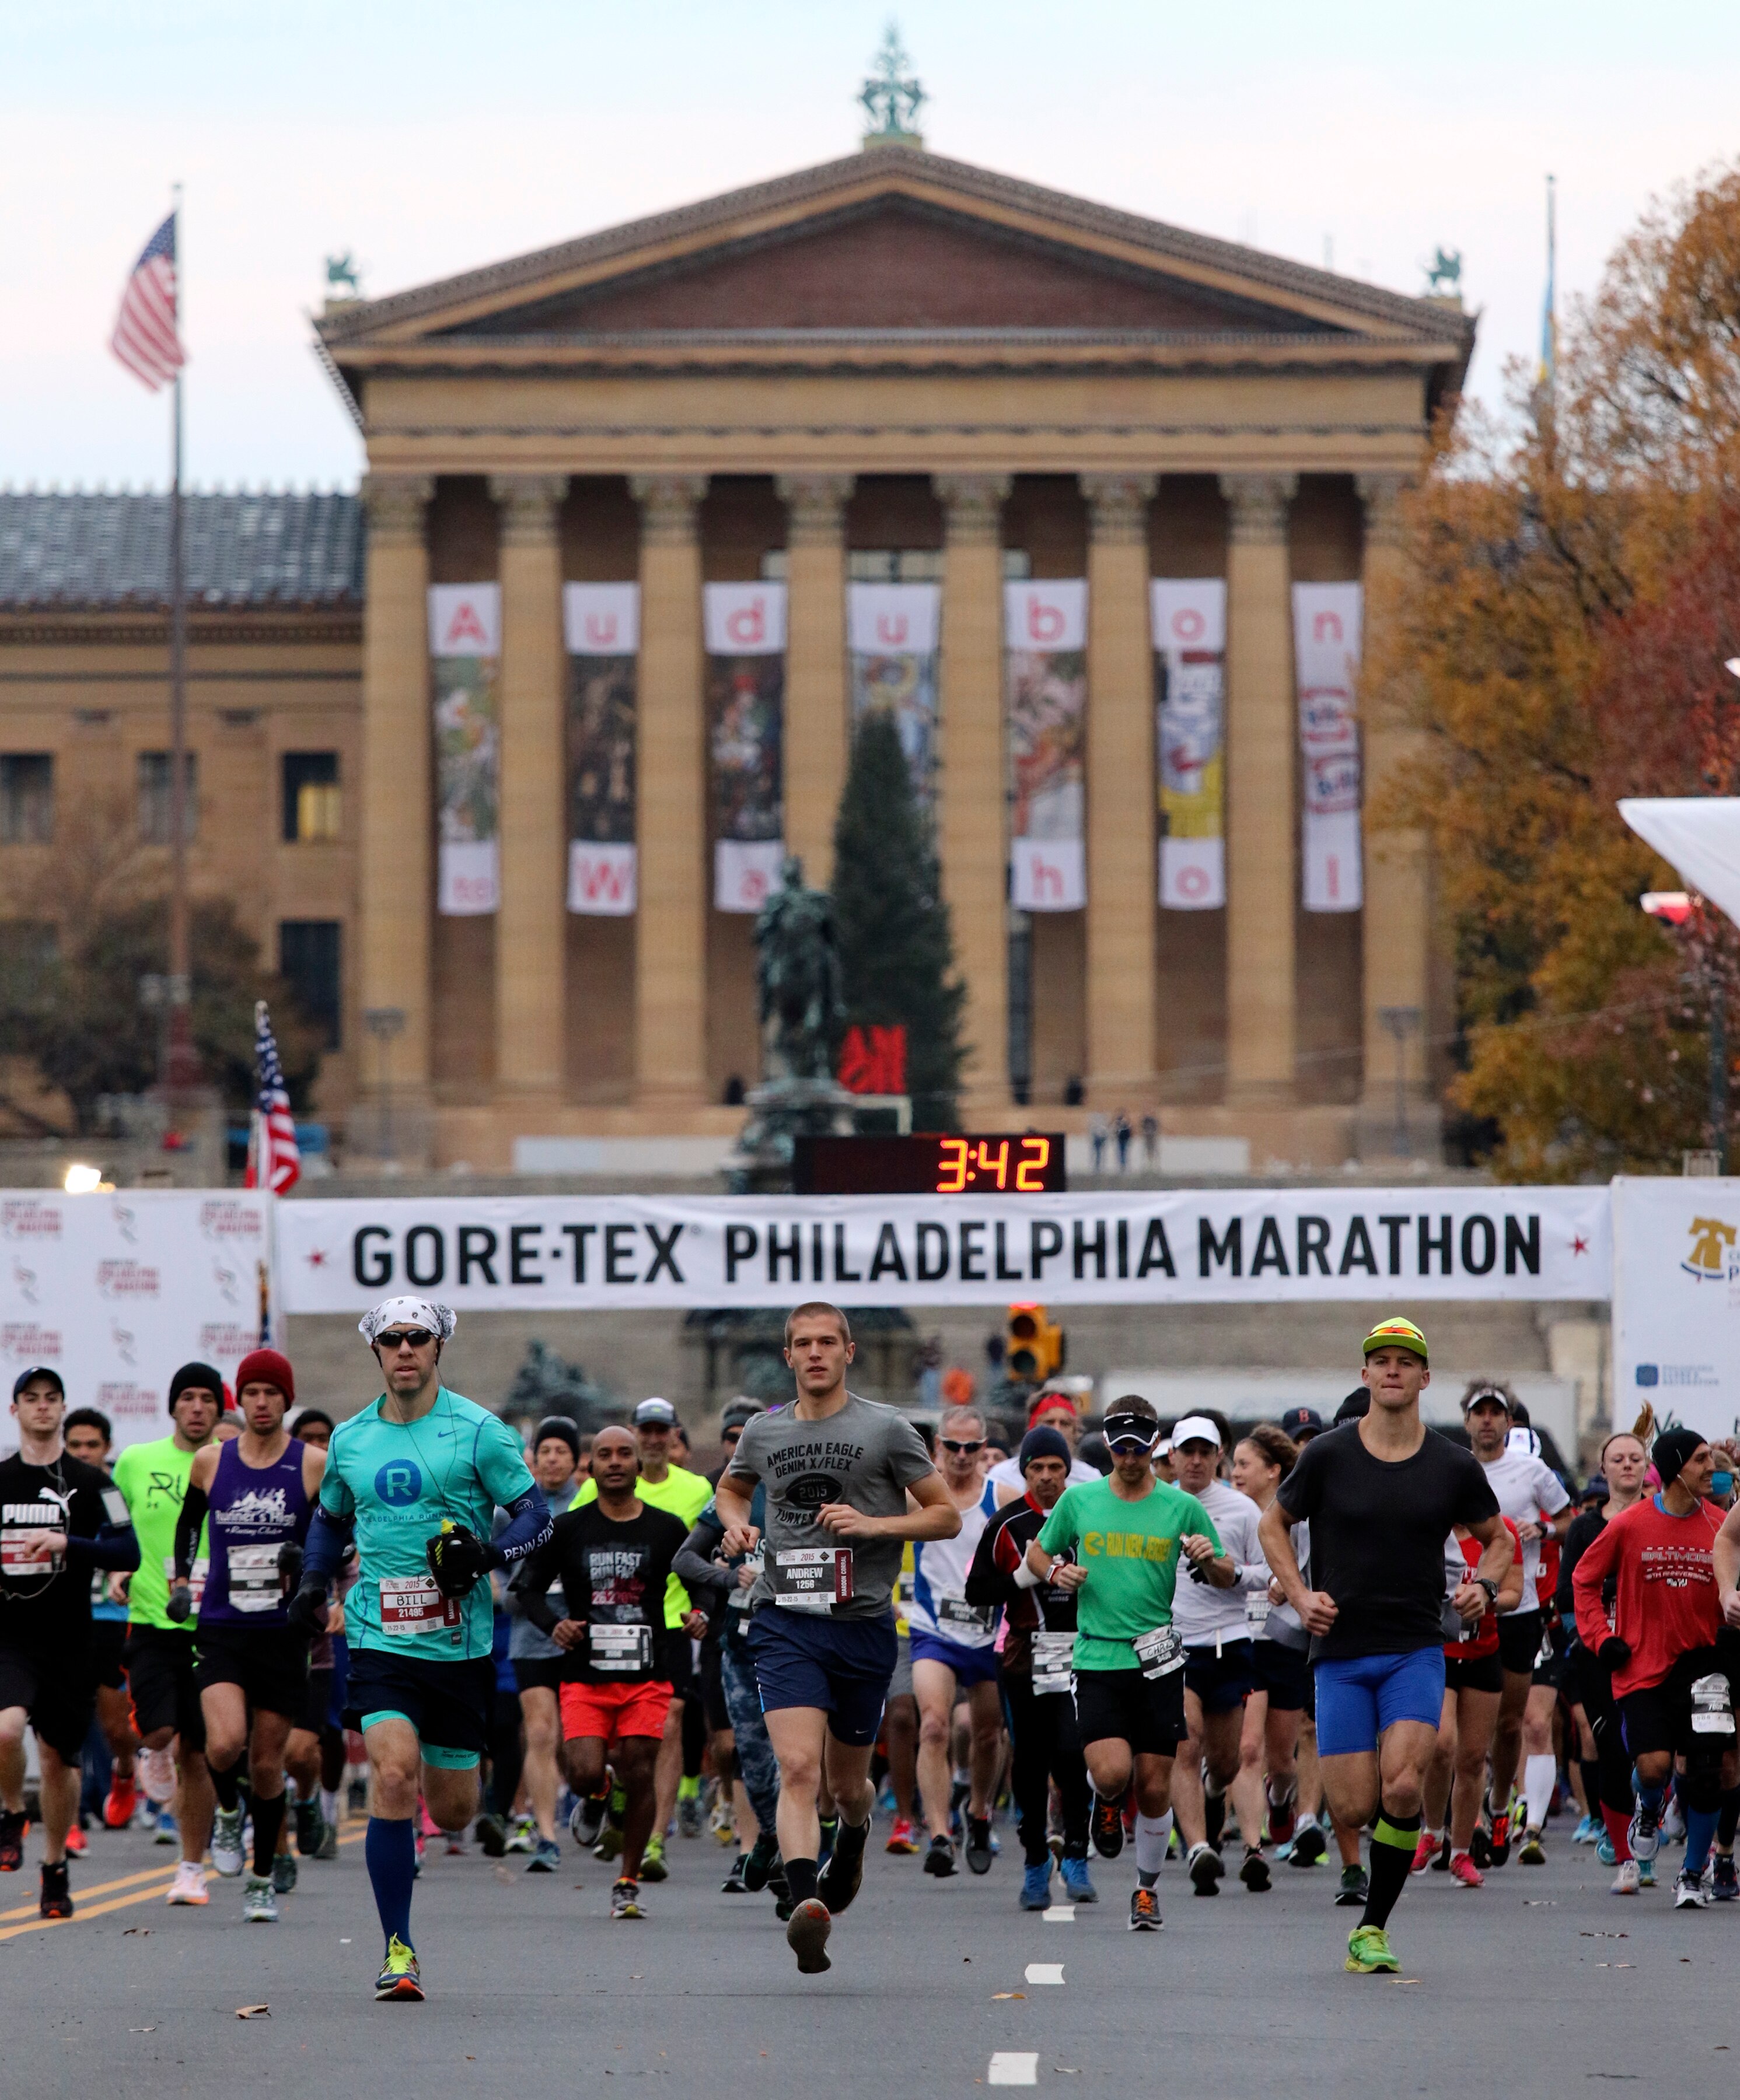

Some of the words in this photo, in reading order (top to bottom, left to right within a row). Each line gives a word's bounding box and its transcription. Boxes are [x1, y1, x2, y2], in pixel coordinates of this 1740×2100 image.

[937, 1139, 1049, 1192] 3:42
[725, 1218, 1176, 1283] PHILADELPHIA
[1198, 1213, 1540, 1277] MARATHON
[767, 1443, 822, 1468] AMERICAN
[826, 1443, 864, 1460] EAGLE
[775, 1458, 806, 1479] DENIM
[809, 1457, 852, 1472] X/FLEX
[387, 1468, 413, 1497] R
[799, 1485, 827, 1499] 2015
[2, 1503, 60, 1524] PUMA
[504, 1538, 536, 1561] PENN
[1106, 1532, 1123, 1557] RUN
[590, 1552, 614, 1567] RUN
[614, 1552, 642, 1567] FAST
[591, 1565, 614, 1580] RUN
[787, 1567, 823, 1579] ANDREW
[406, 1581, 420, 1589] 2015
[397, 1594, 427, 1606] BILL
[398, 1607, 424, 1618] 21495
